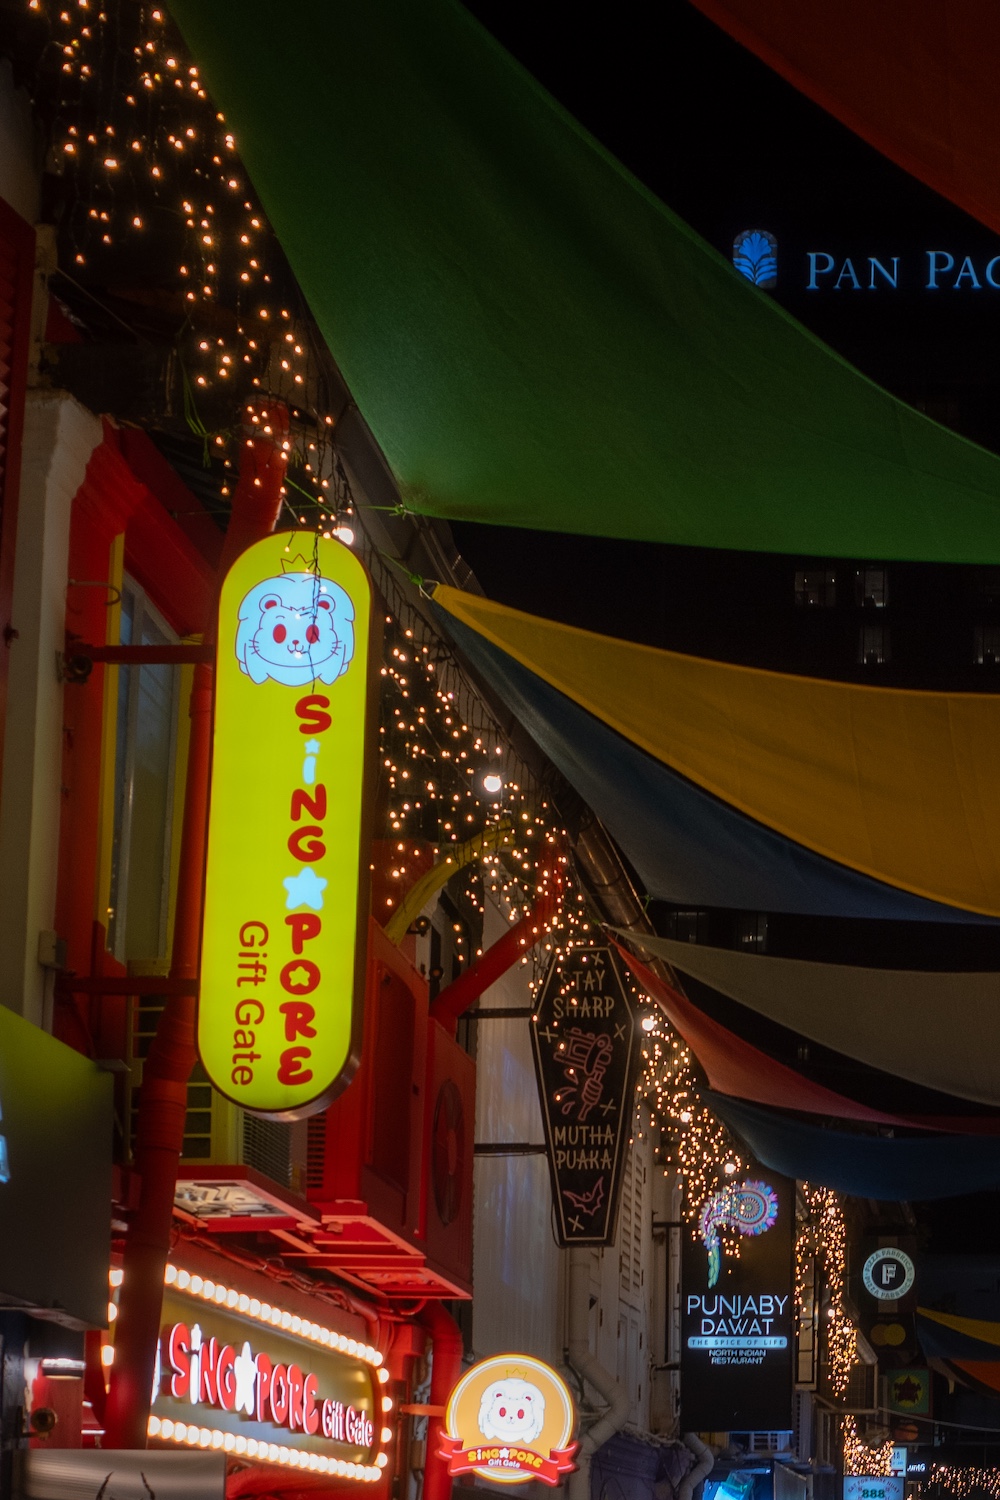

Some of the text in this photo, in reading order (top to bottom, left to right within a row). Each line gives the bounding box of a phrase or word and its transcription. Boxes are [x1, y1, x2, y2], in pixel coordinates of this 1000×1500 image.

[805, 251, 900, 290] PAN
[231, 920, 269, 1086] Gift Gate
[553, 996, 615, 1018] SHARP
[554, 1124, 615, 1147] MUTHA
[556, 1149, 612, 1170] PUAKA
[881, 1263, 897, 1285] F
[687, 1295, 789, 1320] PUNJABY
[701, 1318, 774, 1336] DAWAT
[711, 1357, 764, 1365] RESTAURANT
[321, 1398, 345, 1442] Gift
[345, 1405, 374, 1449] Gate
[862, 1489, 885, 1498] 888
